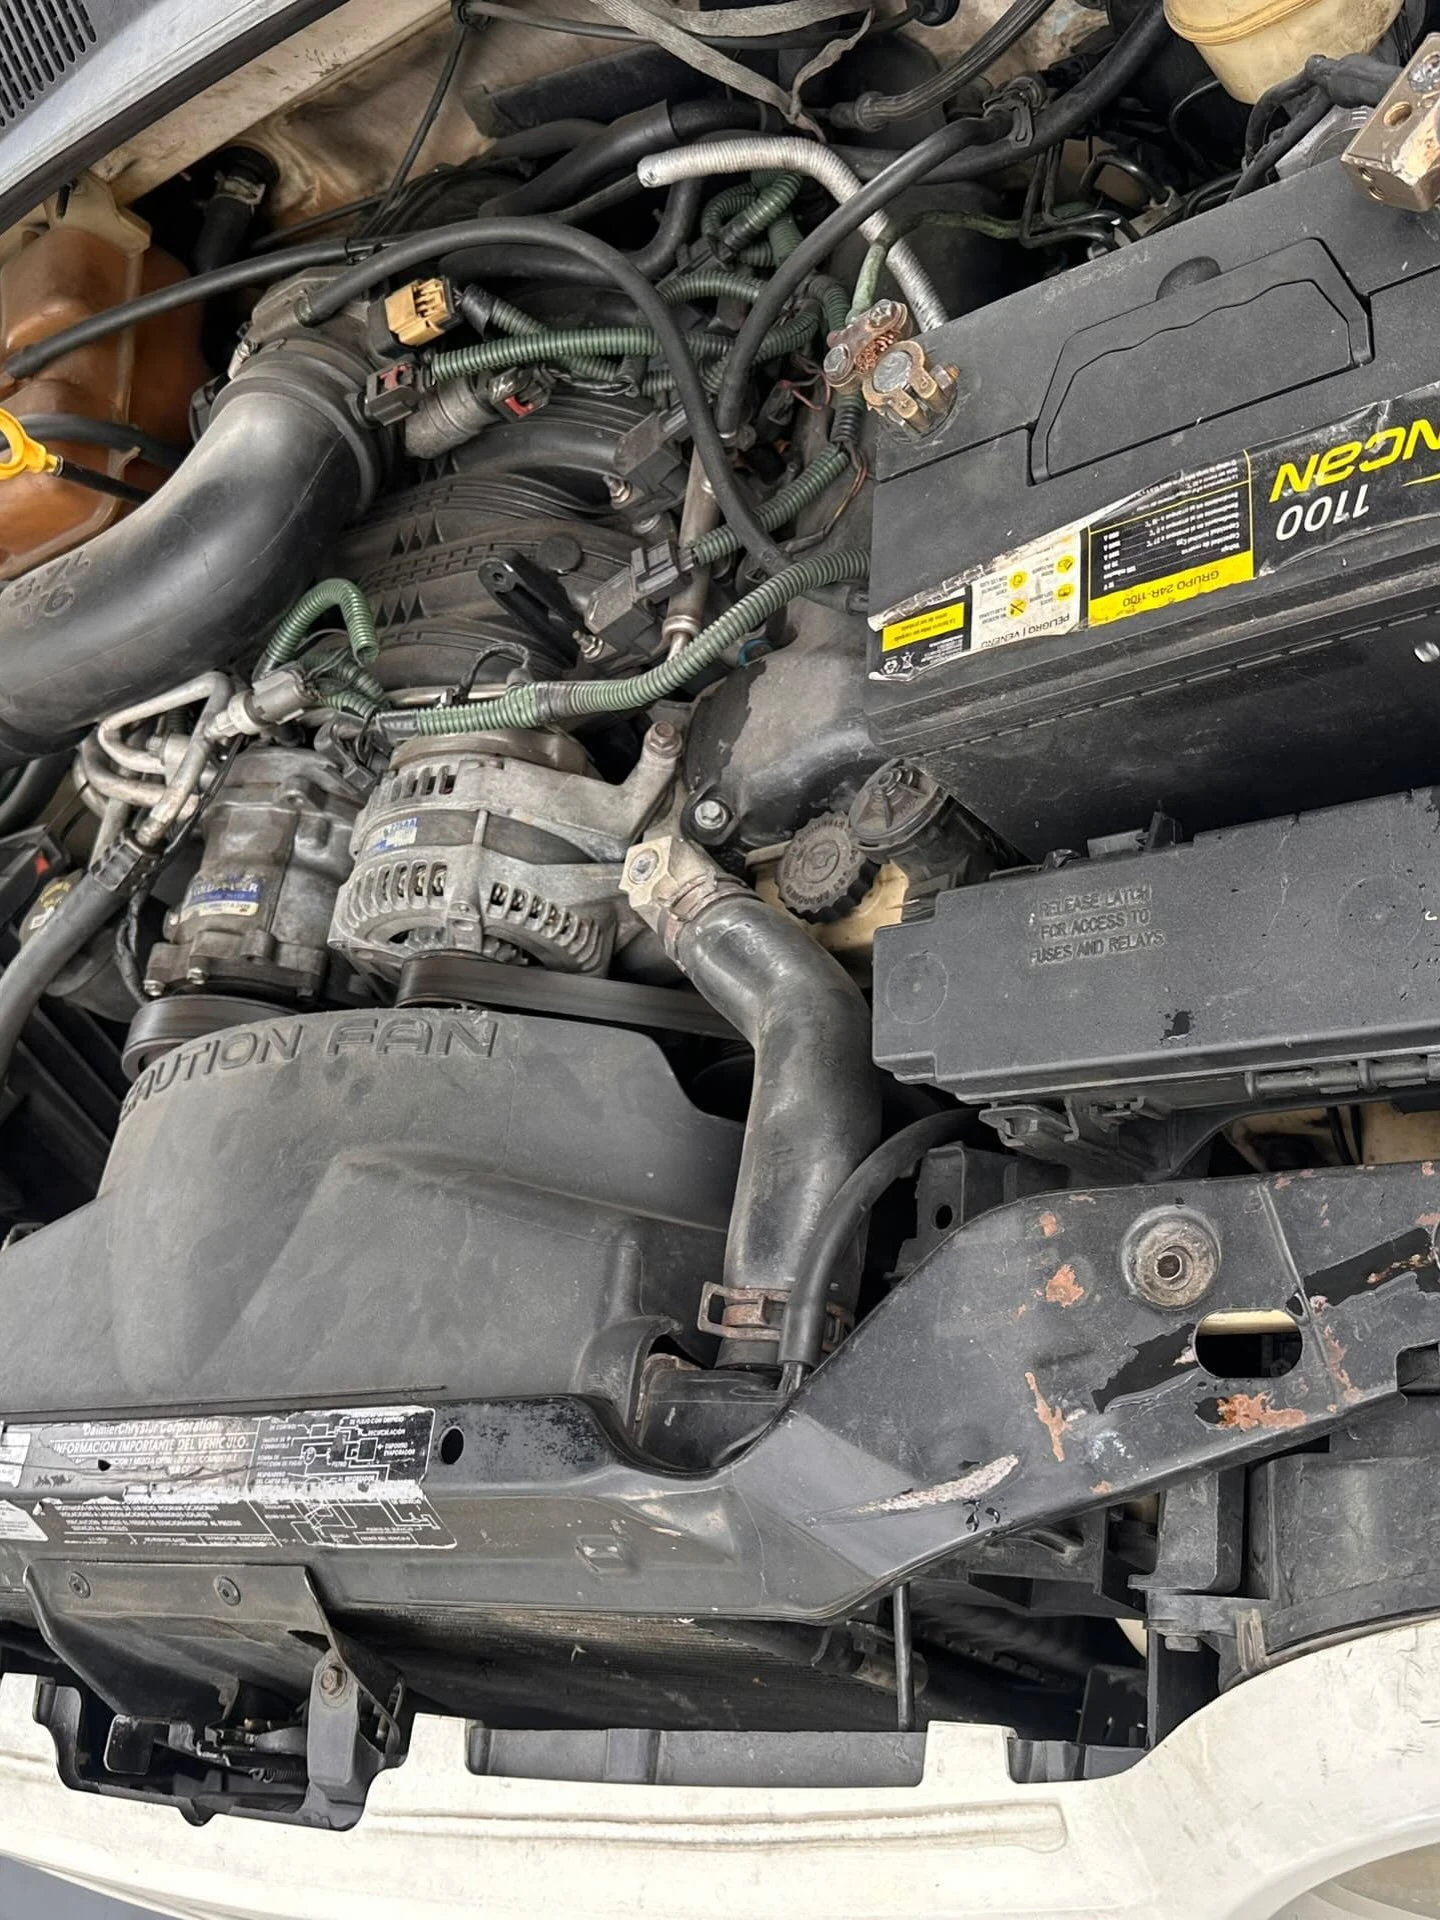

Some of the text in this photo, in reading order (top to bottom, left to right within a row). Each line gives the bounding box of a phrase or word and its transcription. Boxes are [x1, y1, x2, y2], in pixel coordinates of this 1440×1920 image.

[1276, 484, 1369, 540] 1100
[1122, 570, 1219, 606] GRUPO 24R-1100
[1028, 613, 1070, 634] PELIGRO
[1040, 884, 1152, 917] RELEASE LATCH
[1041, 908, 1150, 940] FOR ACCESS TO
[1029, 929, 1164, 964] FUSES AND RELAYS
[120, 1017, 499, 1122] CAUTION FAN
[159, 1420, 220, 1434] Corporation
[118, 1437, 174, 1452] IMPORTANTE
[178, 1438, 196, 1450] DEL
